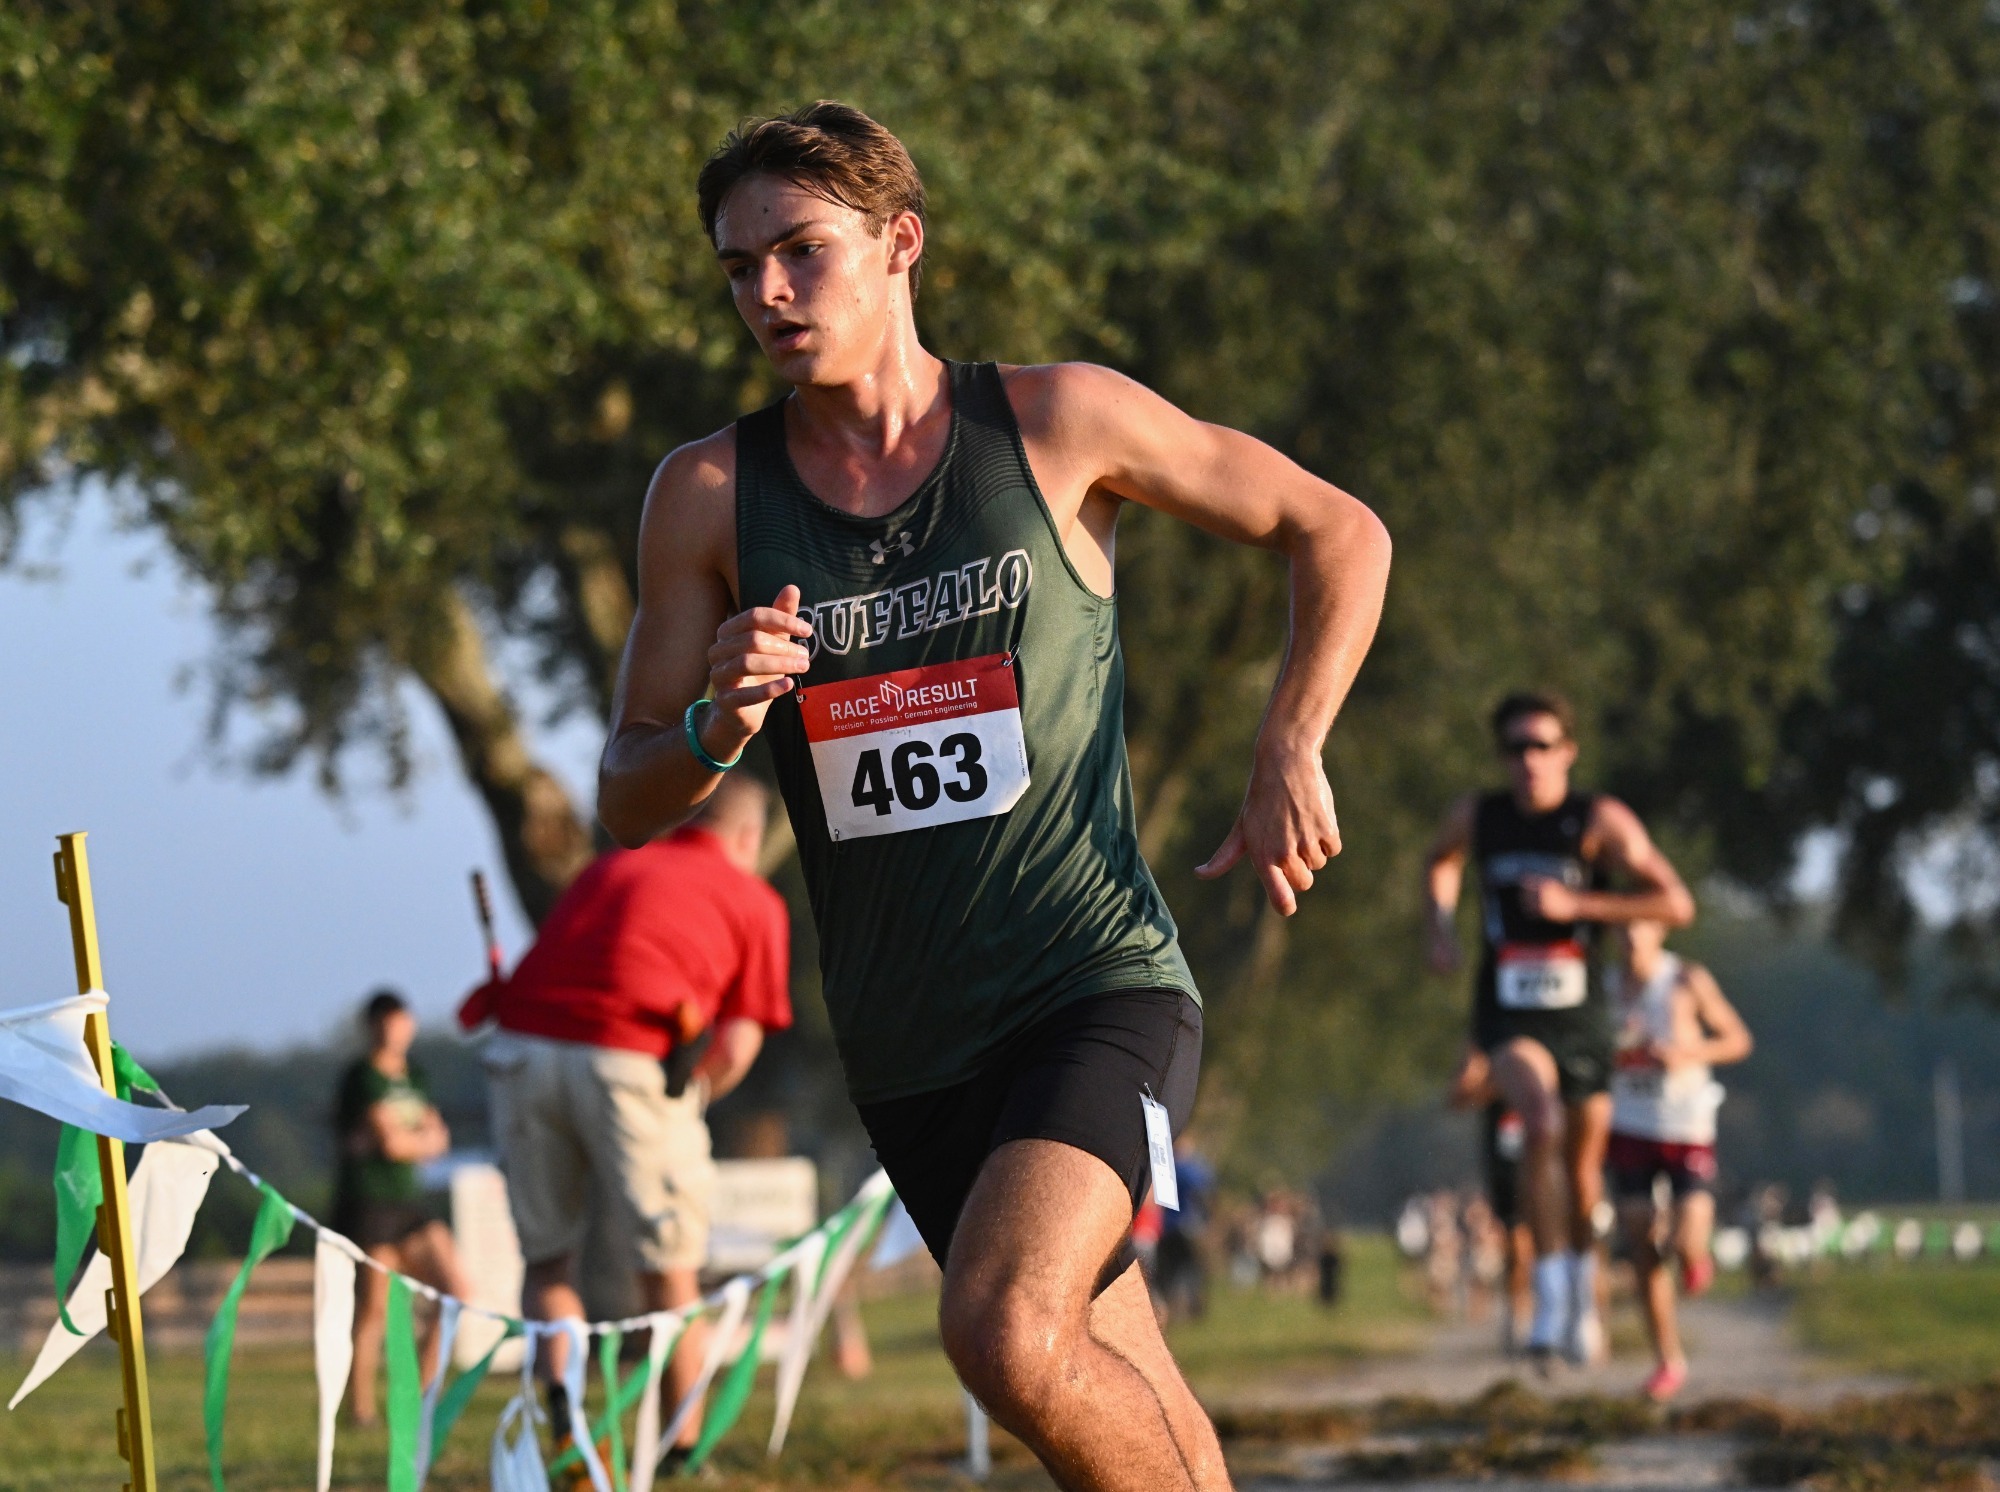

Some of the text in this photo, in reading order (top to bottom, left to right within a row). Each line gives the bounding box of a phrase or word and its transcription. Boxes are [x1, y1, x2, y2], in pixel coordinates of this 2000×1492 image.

[830, 678, 978, 721] RACE RESULT
[833, 701, 978, 732] Precision Passion German Engineering
[850, 732, 988, 816] 463
